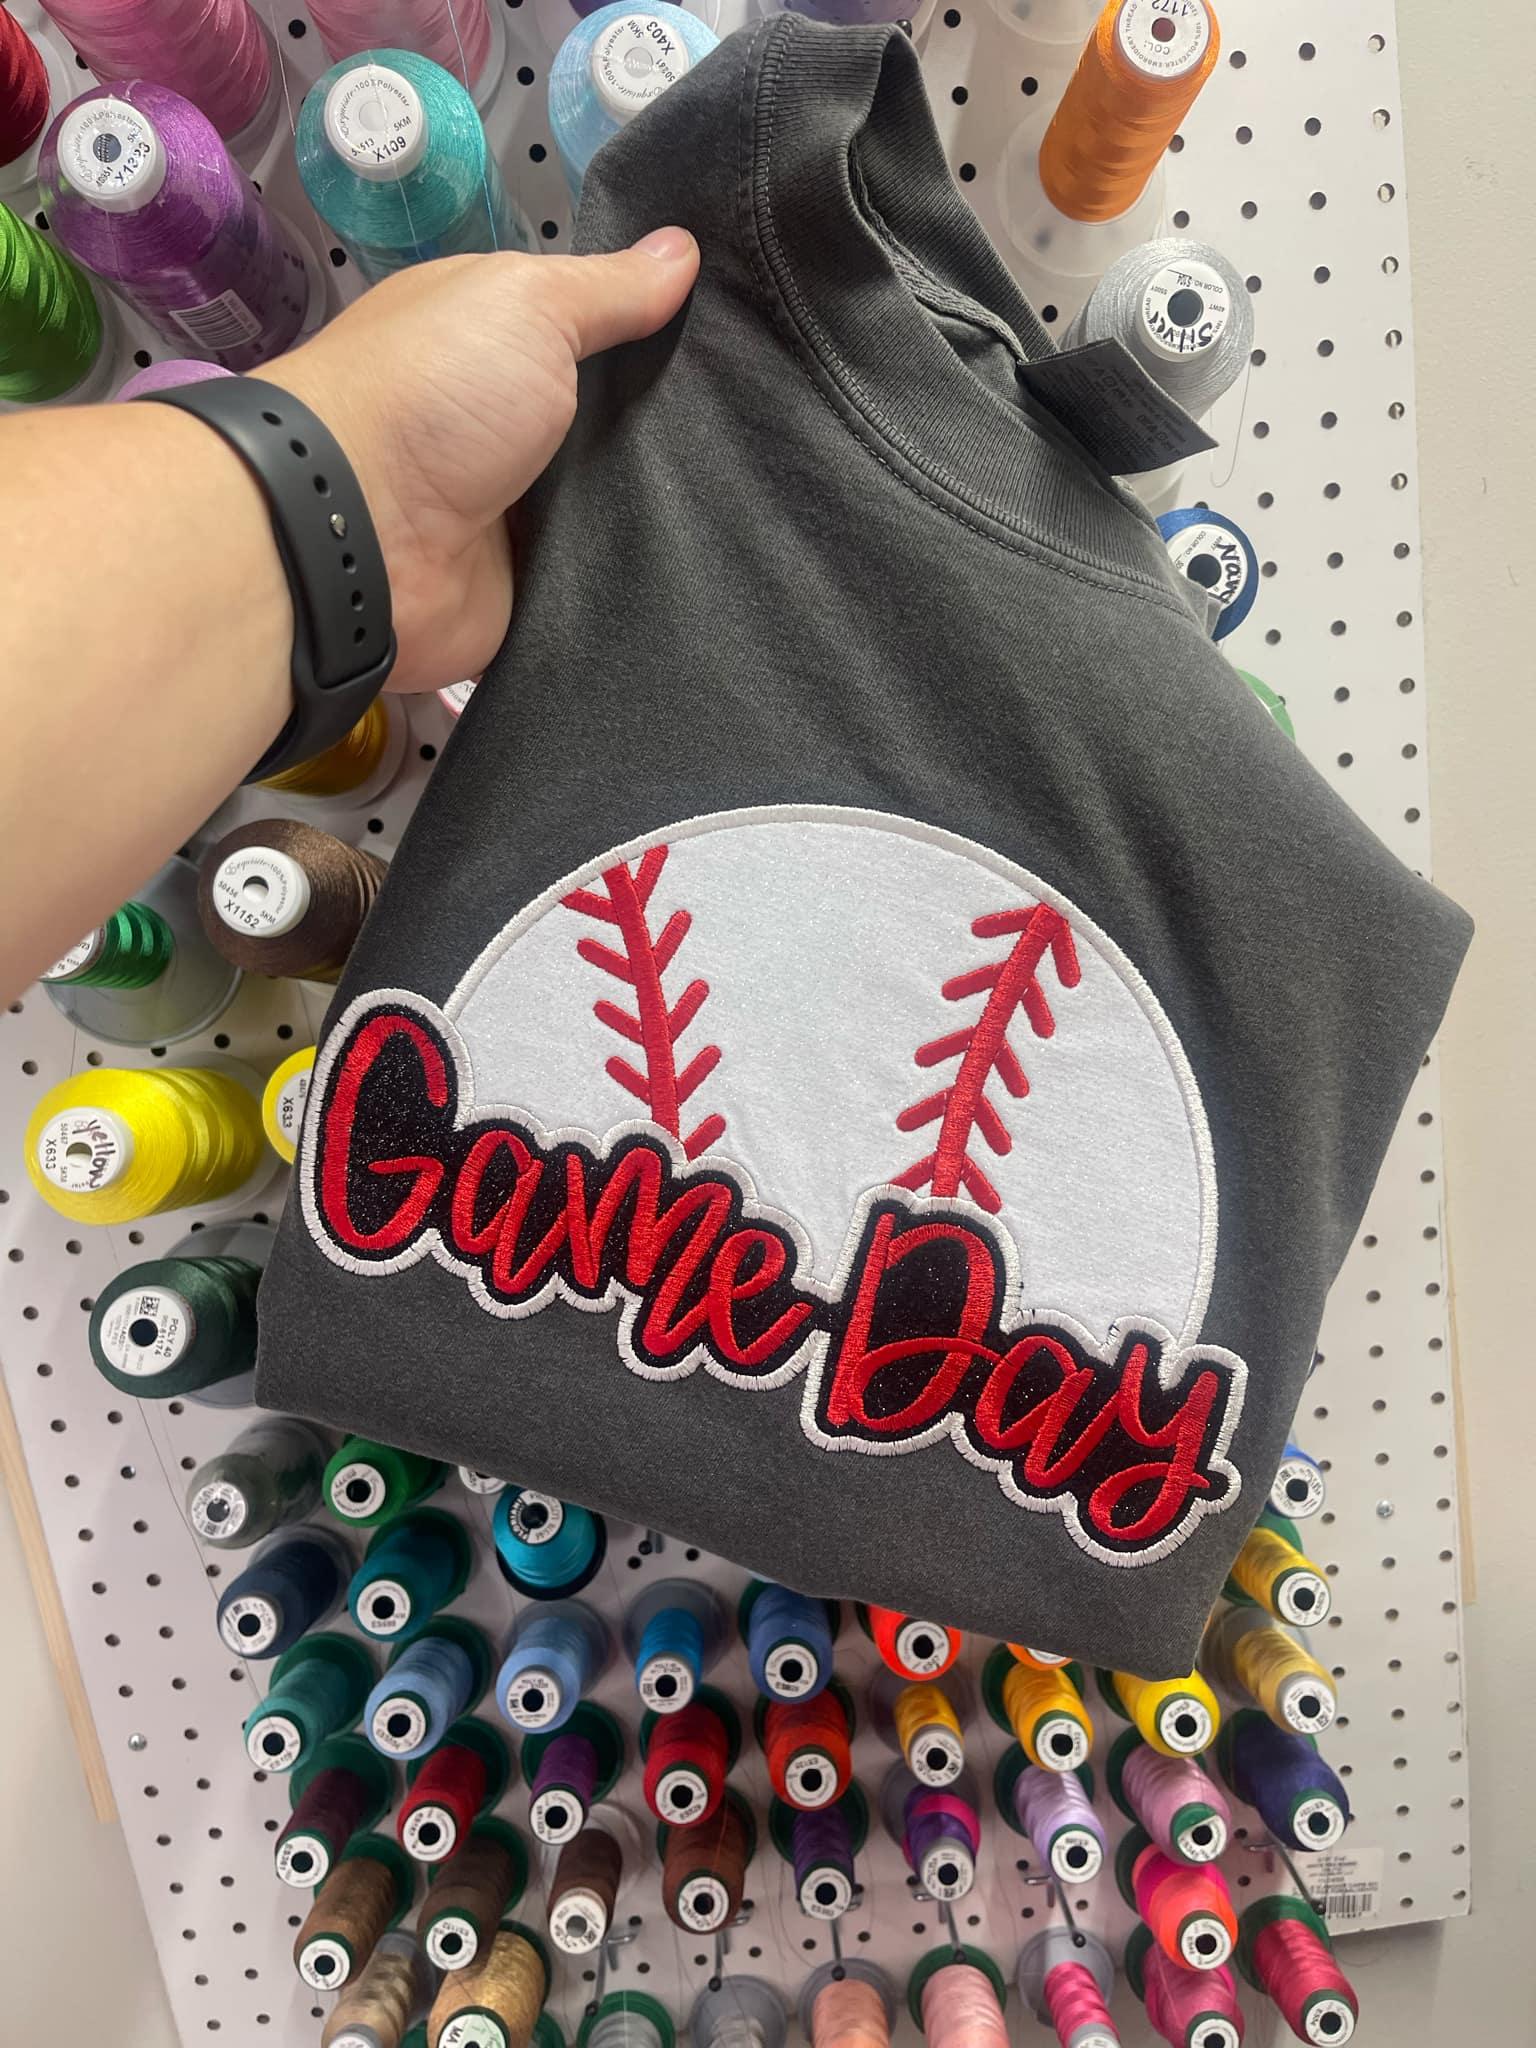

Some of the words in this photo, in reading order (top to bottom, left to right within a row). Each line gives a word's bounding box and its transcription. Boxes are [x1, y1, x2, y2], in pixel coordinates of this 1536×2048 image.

[646, 21, 676, 56] X403
[393, 115, 412, 132] 5KM
[372, 136, 407, 163] X109
[1148, 311, 1213, 353] Silver
[1208, 543, 1240, 604] Navy
[223, 899, 260, 929] X1152
[282, 1096, 294, 1129] X633
[45, 1138, 57, 1170] X633
[318, 1014, 813, 1366] Game
[827, 1212, 1220, 1542] Day
